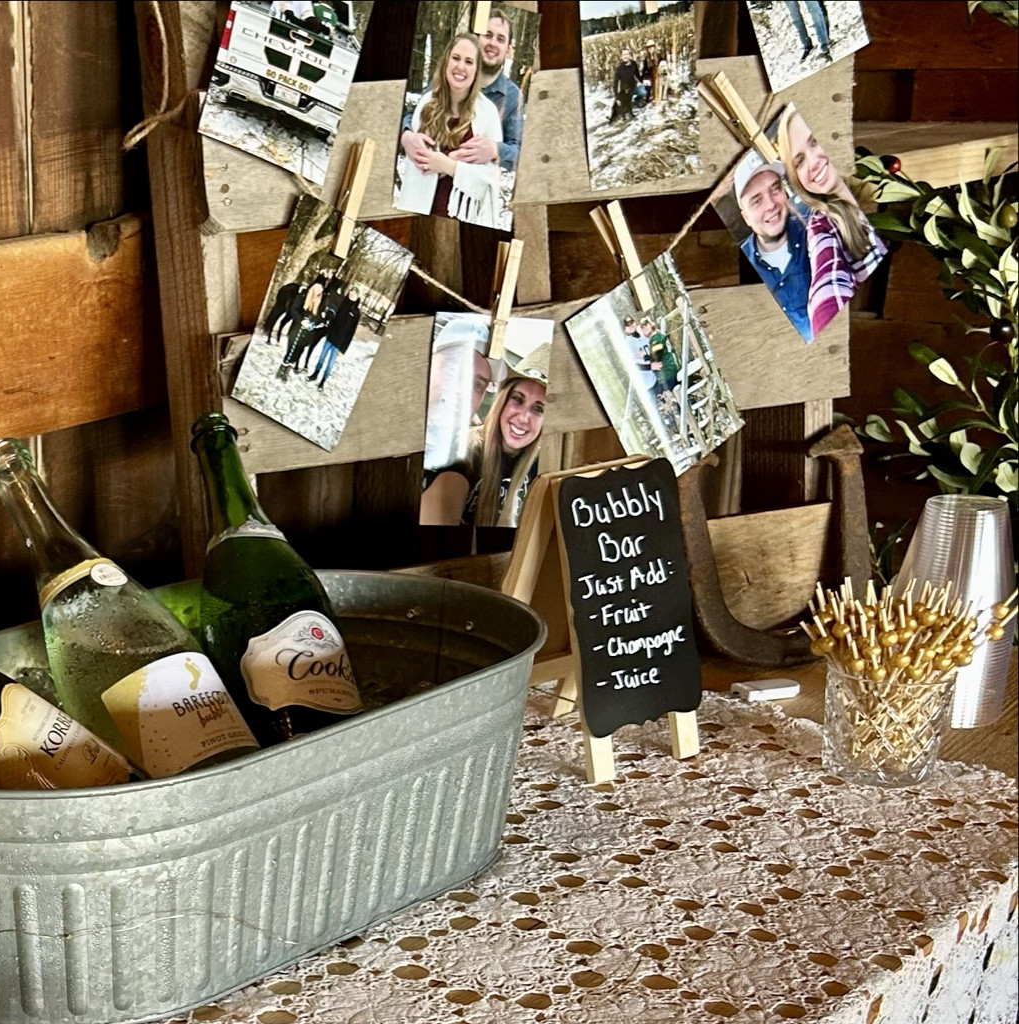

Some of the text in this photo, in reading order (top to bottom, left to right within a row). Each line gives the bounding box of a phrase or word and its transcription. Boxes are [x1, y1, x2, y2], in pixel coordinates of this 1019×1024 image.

[242, 27, 350, 76] CHEVROLET
[265, 69, 277, 79] GO
[278, 73, 298, 87] PACK
[571, 482, 664, 527] Bubbly
[598, 532, 647, 563] Bar
[578, 558, 676, 599] Just Add:
